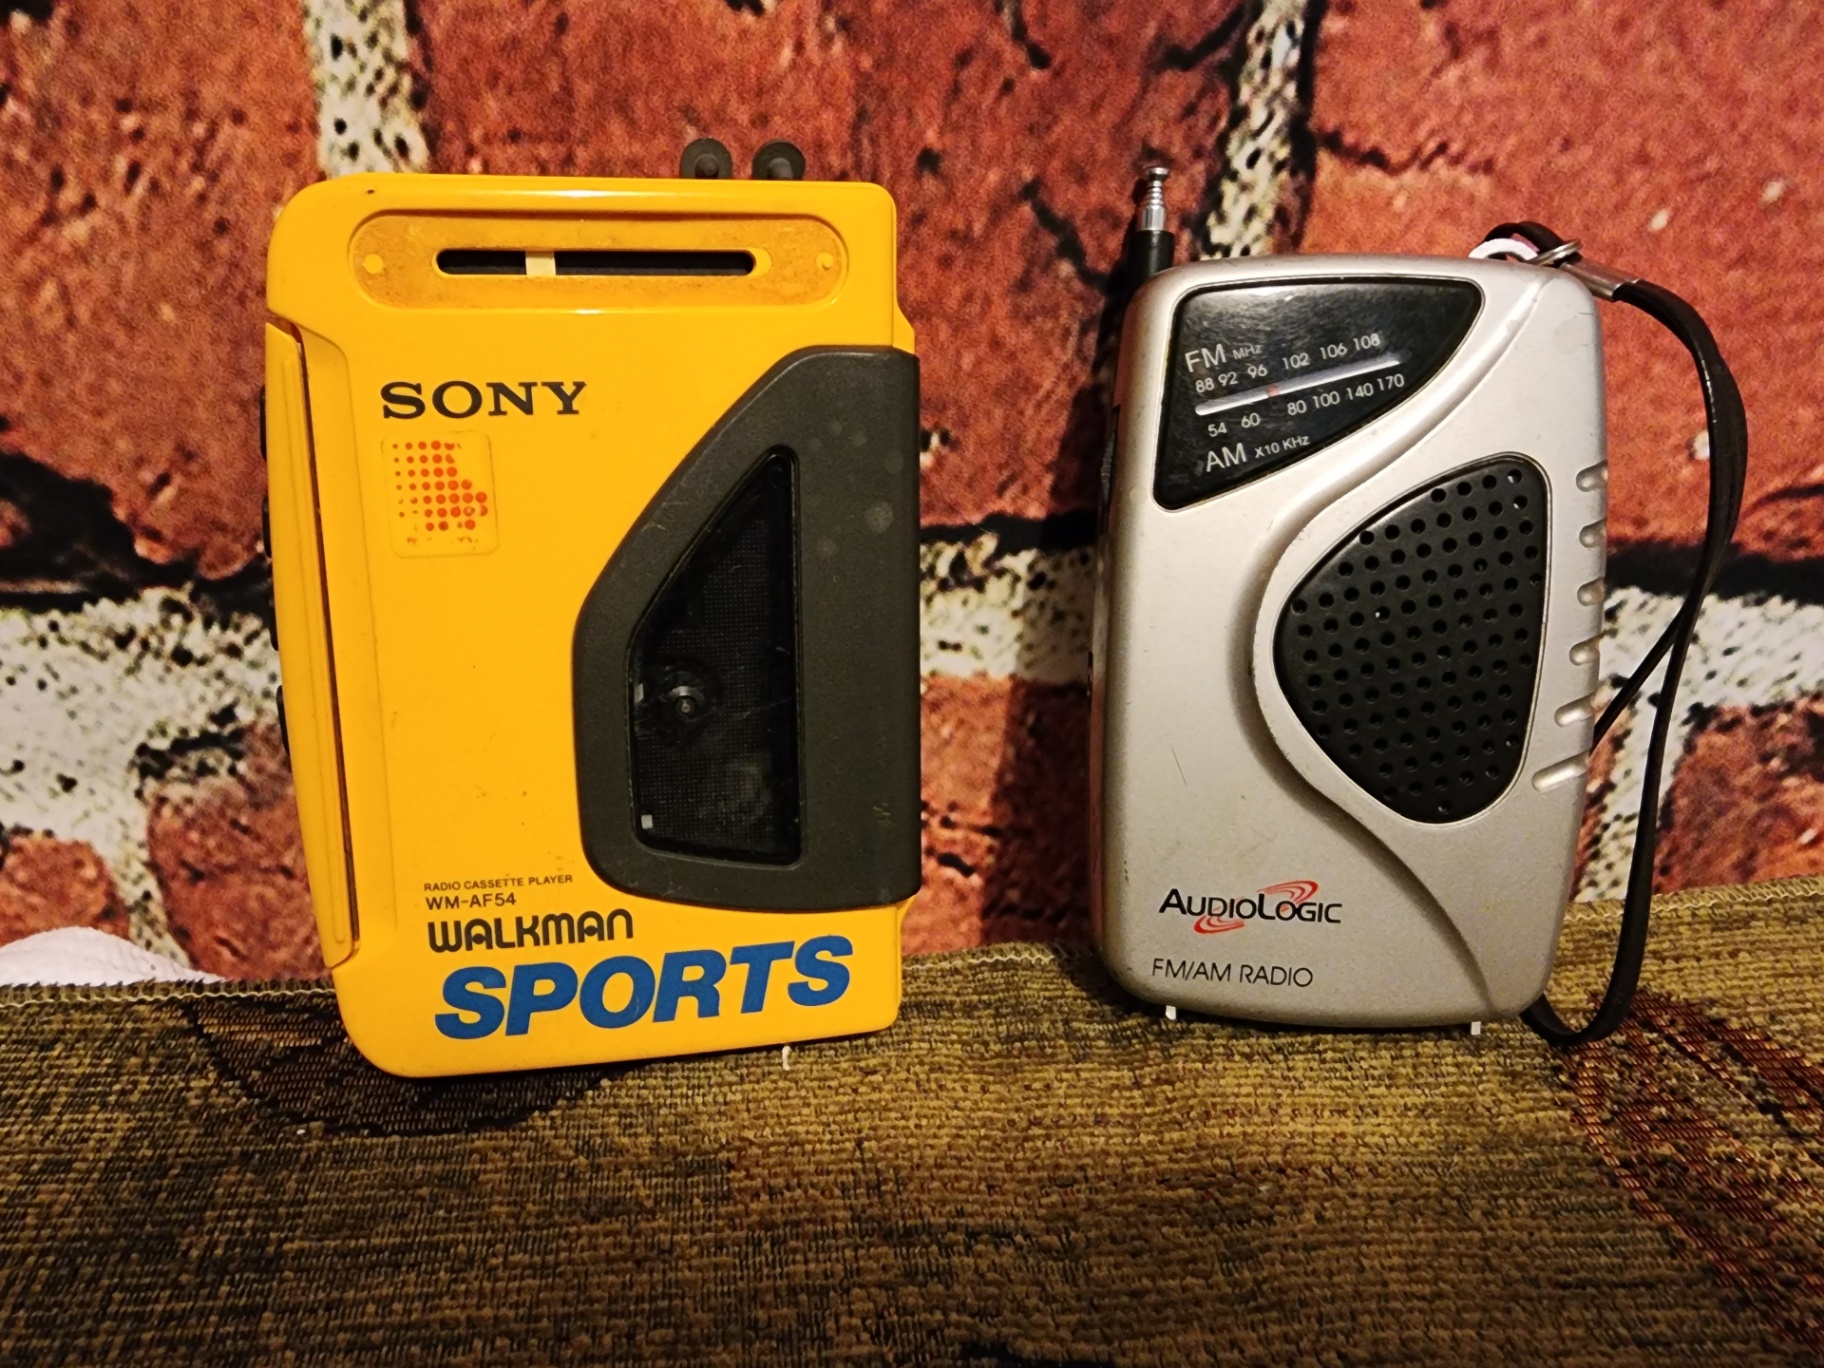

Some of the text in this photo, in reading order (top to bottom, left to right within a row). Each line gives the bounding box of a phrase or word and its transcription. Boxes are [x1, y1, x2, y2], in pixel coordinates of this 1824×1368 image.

[1185, 344, 1227, 373] FM
[1195, 333, 1381, 393] 88 92 96 102 106 108
[380, 380, 587, 420] SONY
[1207, 374, 1405, 437] 54 60 80 100 140 170
[1206, 442, 1247, 472] AM
[1282, 435, 1310, 451] KHz
[424, 874, 573, 891] RADIO CASSETTE PLAYER
[425, 892, 517, 910] WM-AF54
[427, 908, 634, 953] WALKMAN
[435, 935, 853, 1040] SPORTS
[1152, 958, 1313, 987] FM/AM RADIO
